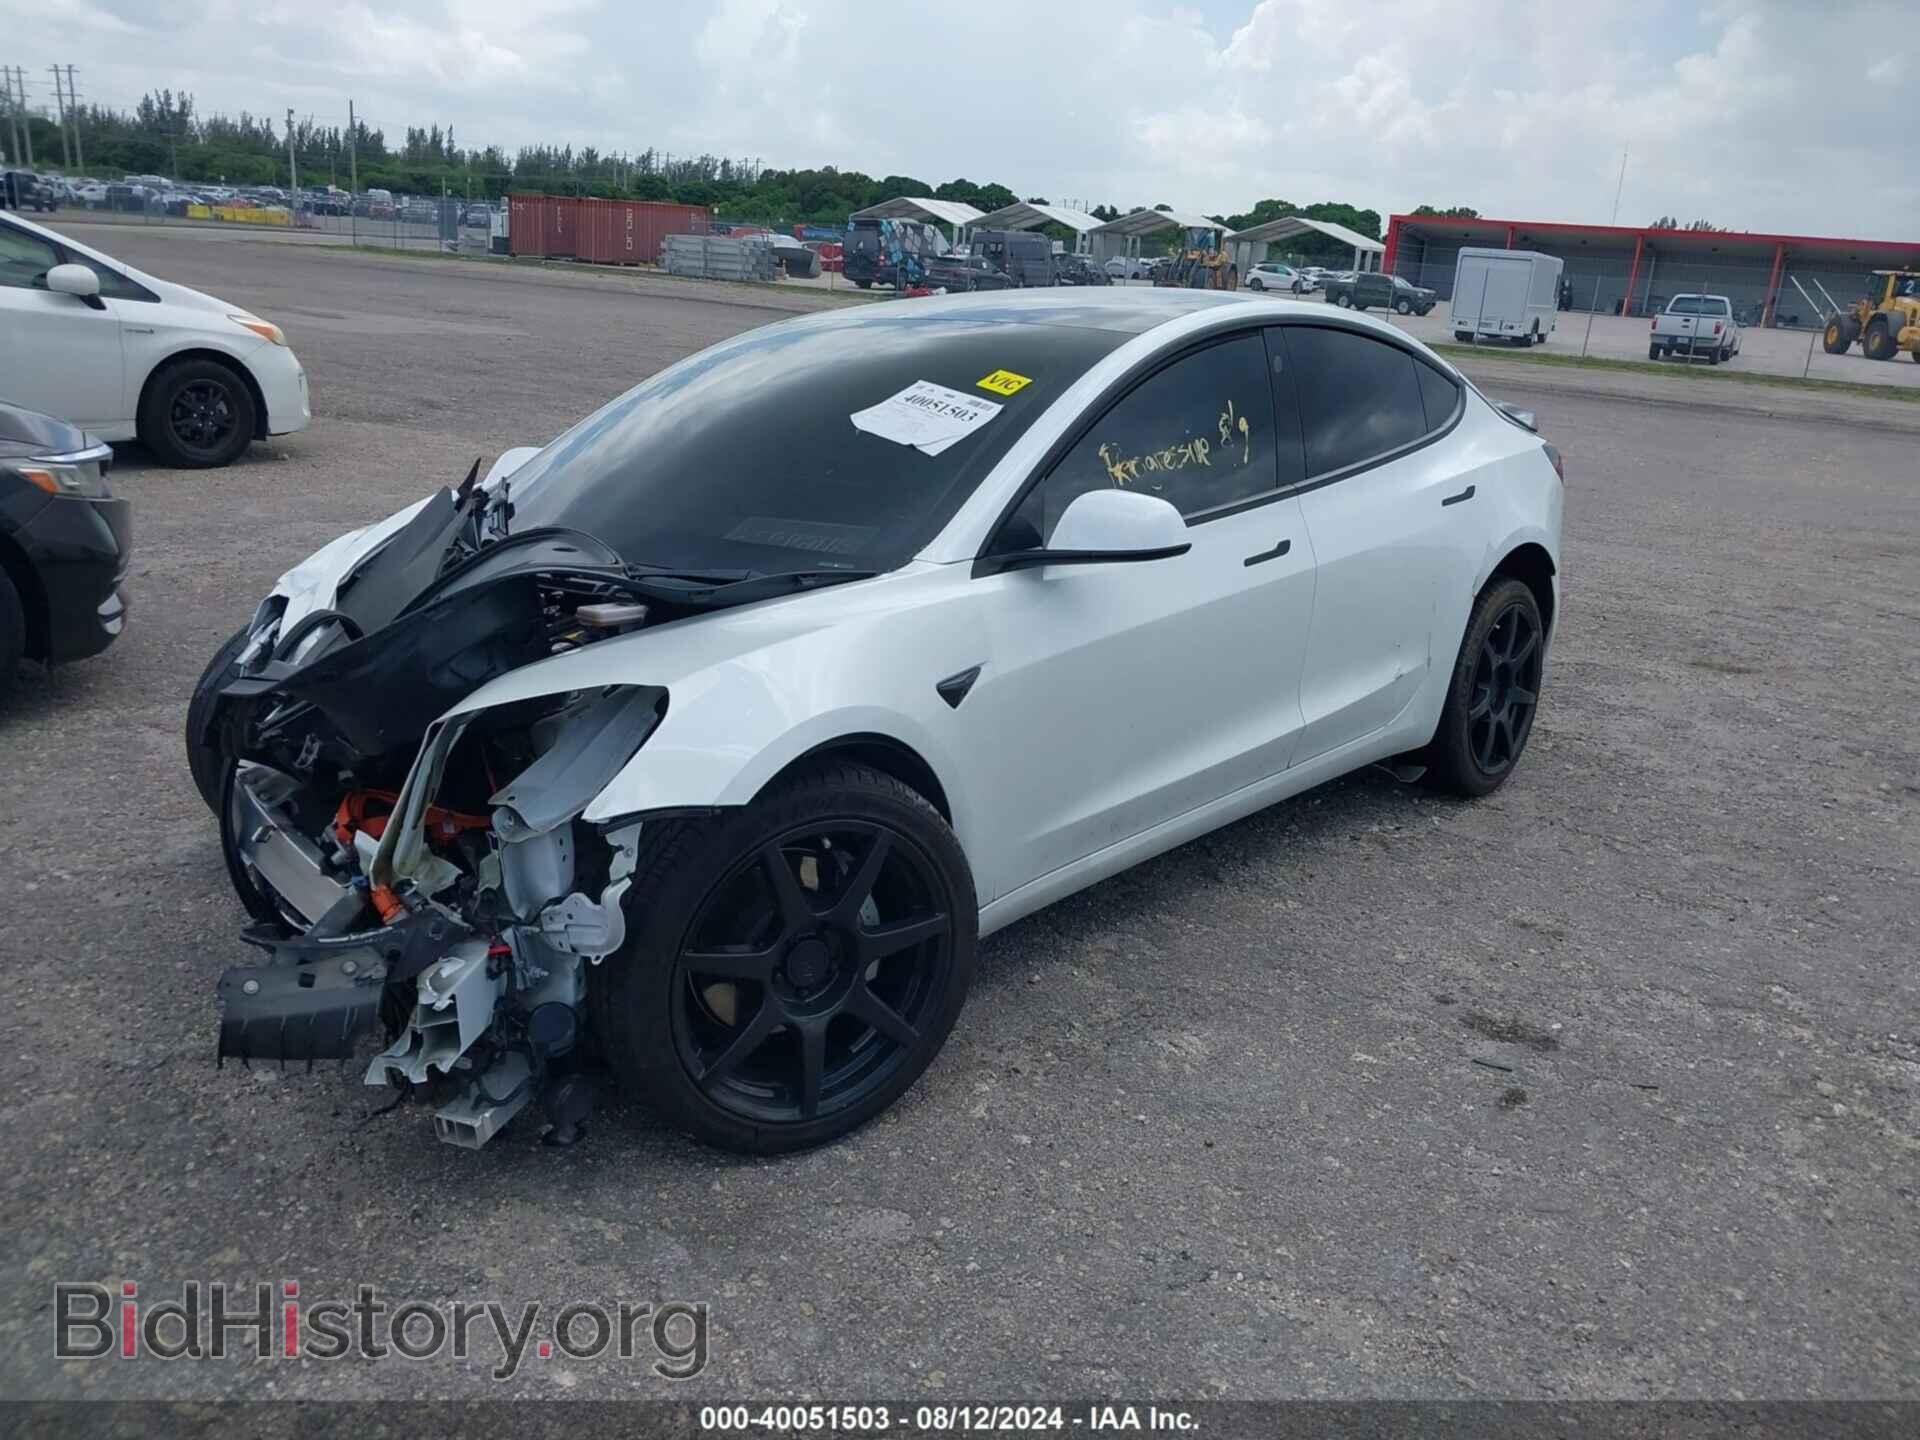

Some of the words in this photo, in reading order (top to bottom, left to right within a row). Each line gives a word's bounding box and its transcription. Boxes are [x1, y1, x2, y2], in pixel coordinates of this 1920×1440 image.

[1904, 279, 1915, 294] 2
[988, 373, 1022, 391] VIC
[903, 393, 979, 422] 40051503
